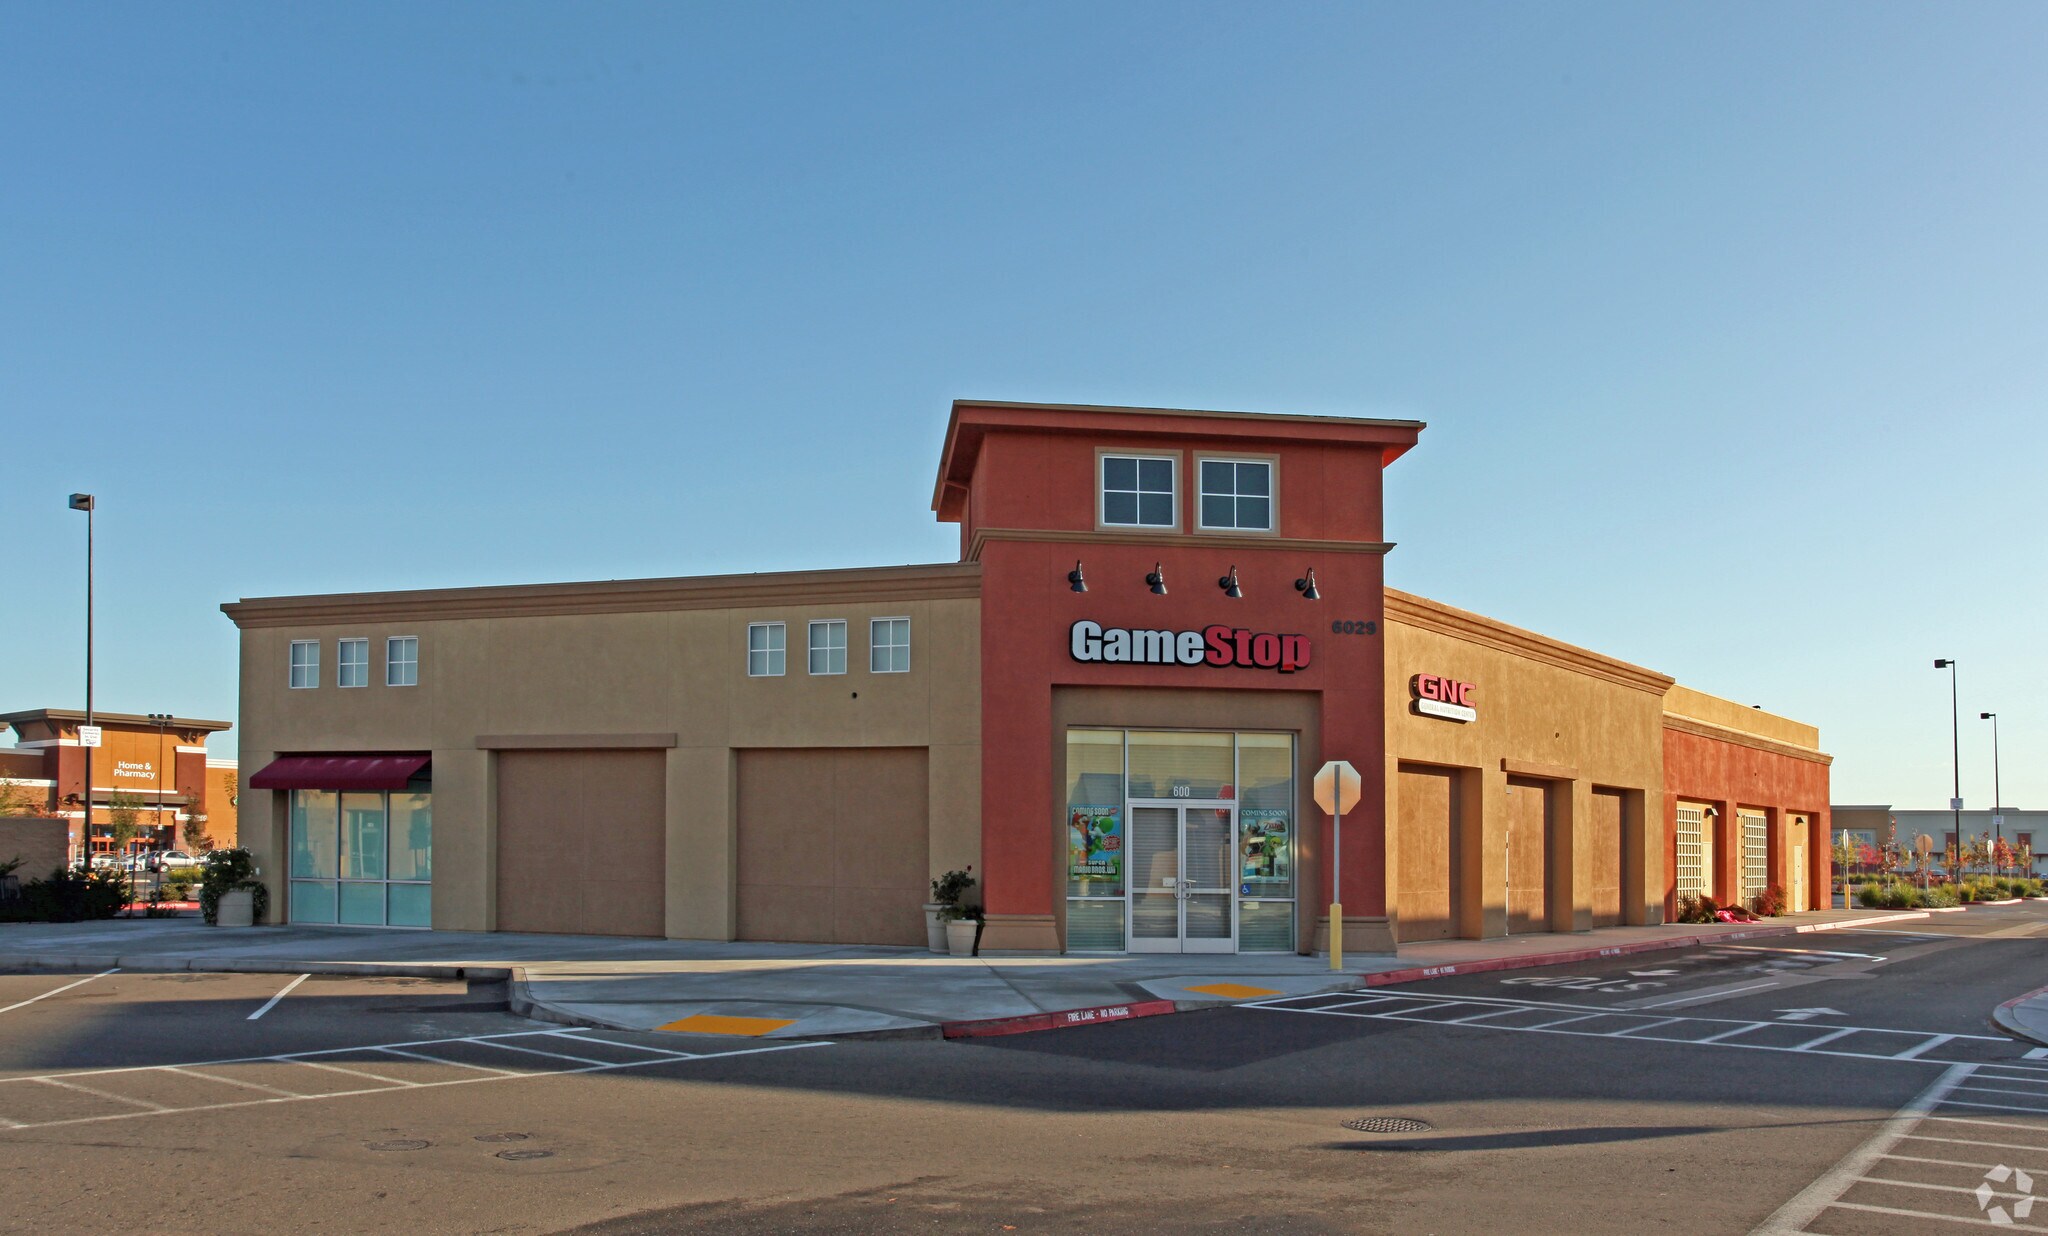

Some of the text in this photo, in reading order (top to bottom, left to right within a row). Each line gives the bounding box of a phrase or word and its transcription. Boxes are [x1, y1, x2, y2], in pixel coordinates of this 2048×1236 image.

[1331, 620, 1377, 635] 6029
[1071, 620, 1311, 672] GameStop
[1418, 673, 1476, 707] GNC
[118, 761, 152, 770] Home &
[113, 769, 156, 780] Pharmacy
[1173, 786, 1190, 797] 600
[1067, 1012, 1080, 1022] FIRE
[1081, 1011, 1095, 1021] LANE
[1100, 1009, 1108, 1018] NO
[1109, 1007, 1129, 1017] PARKING
